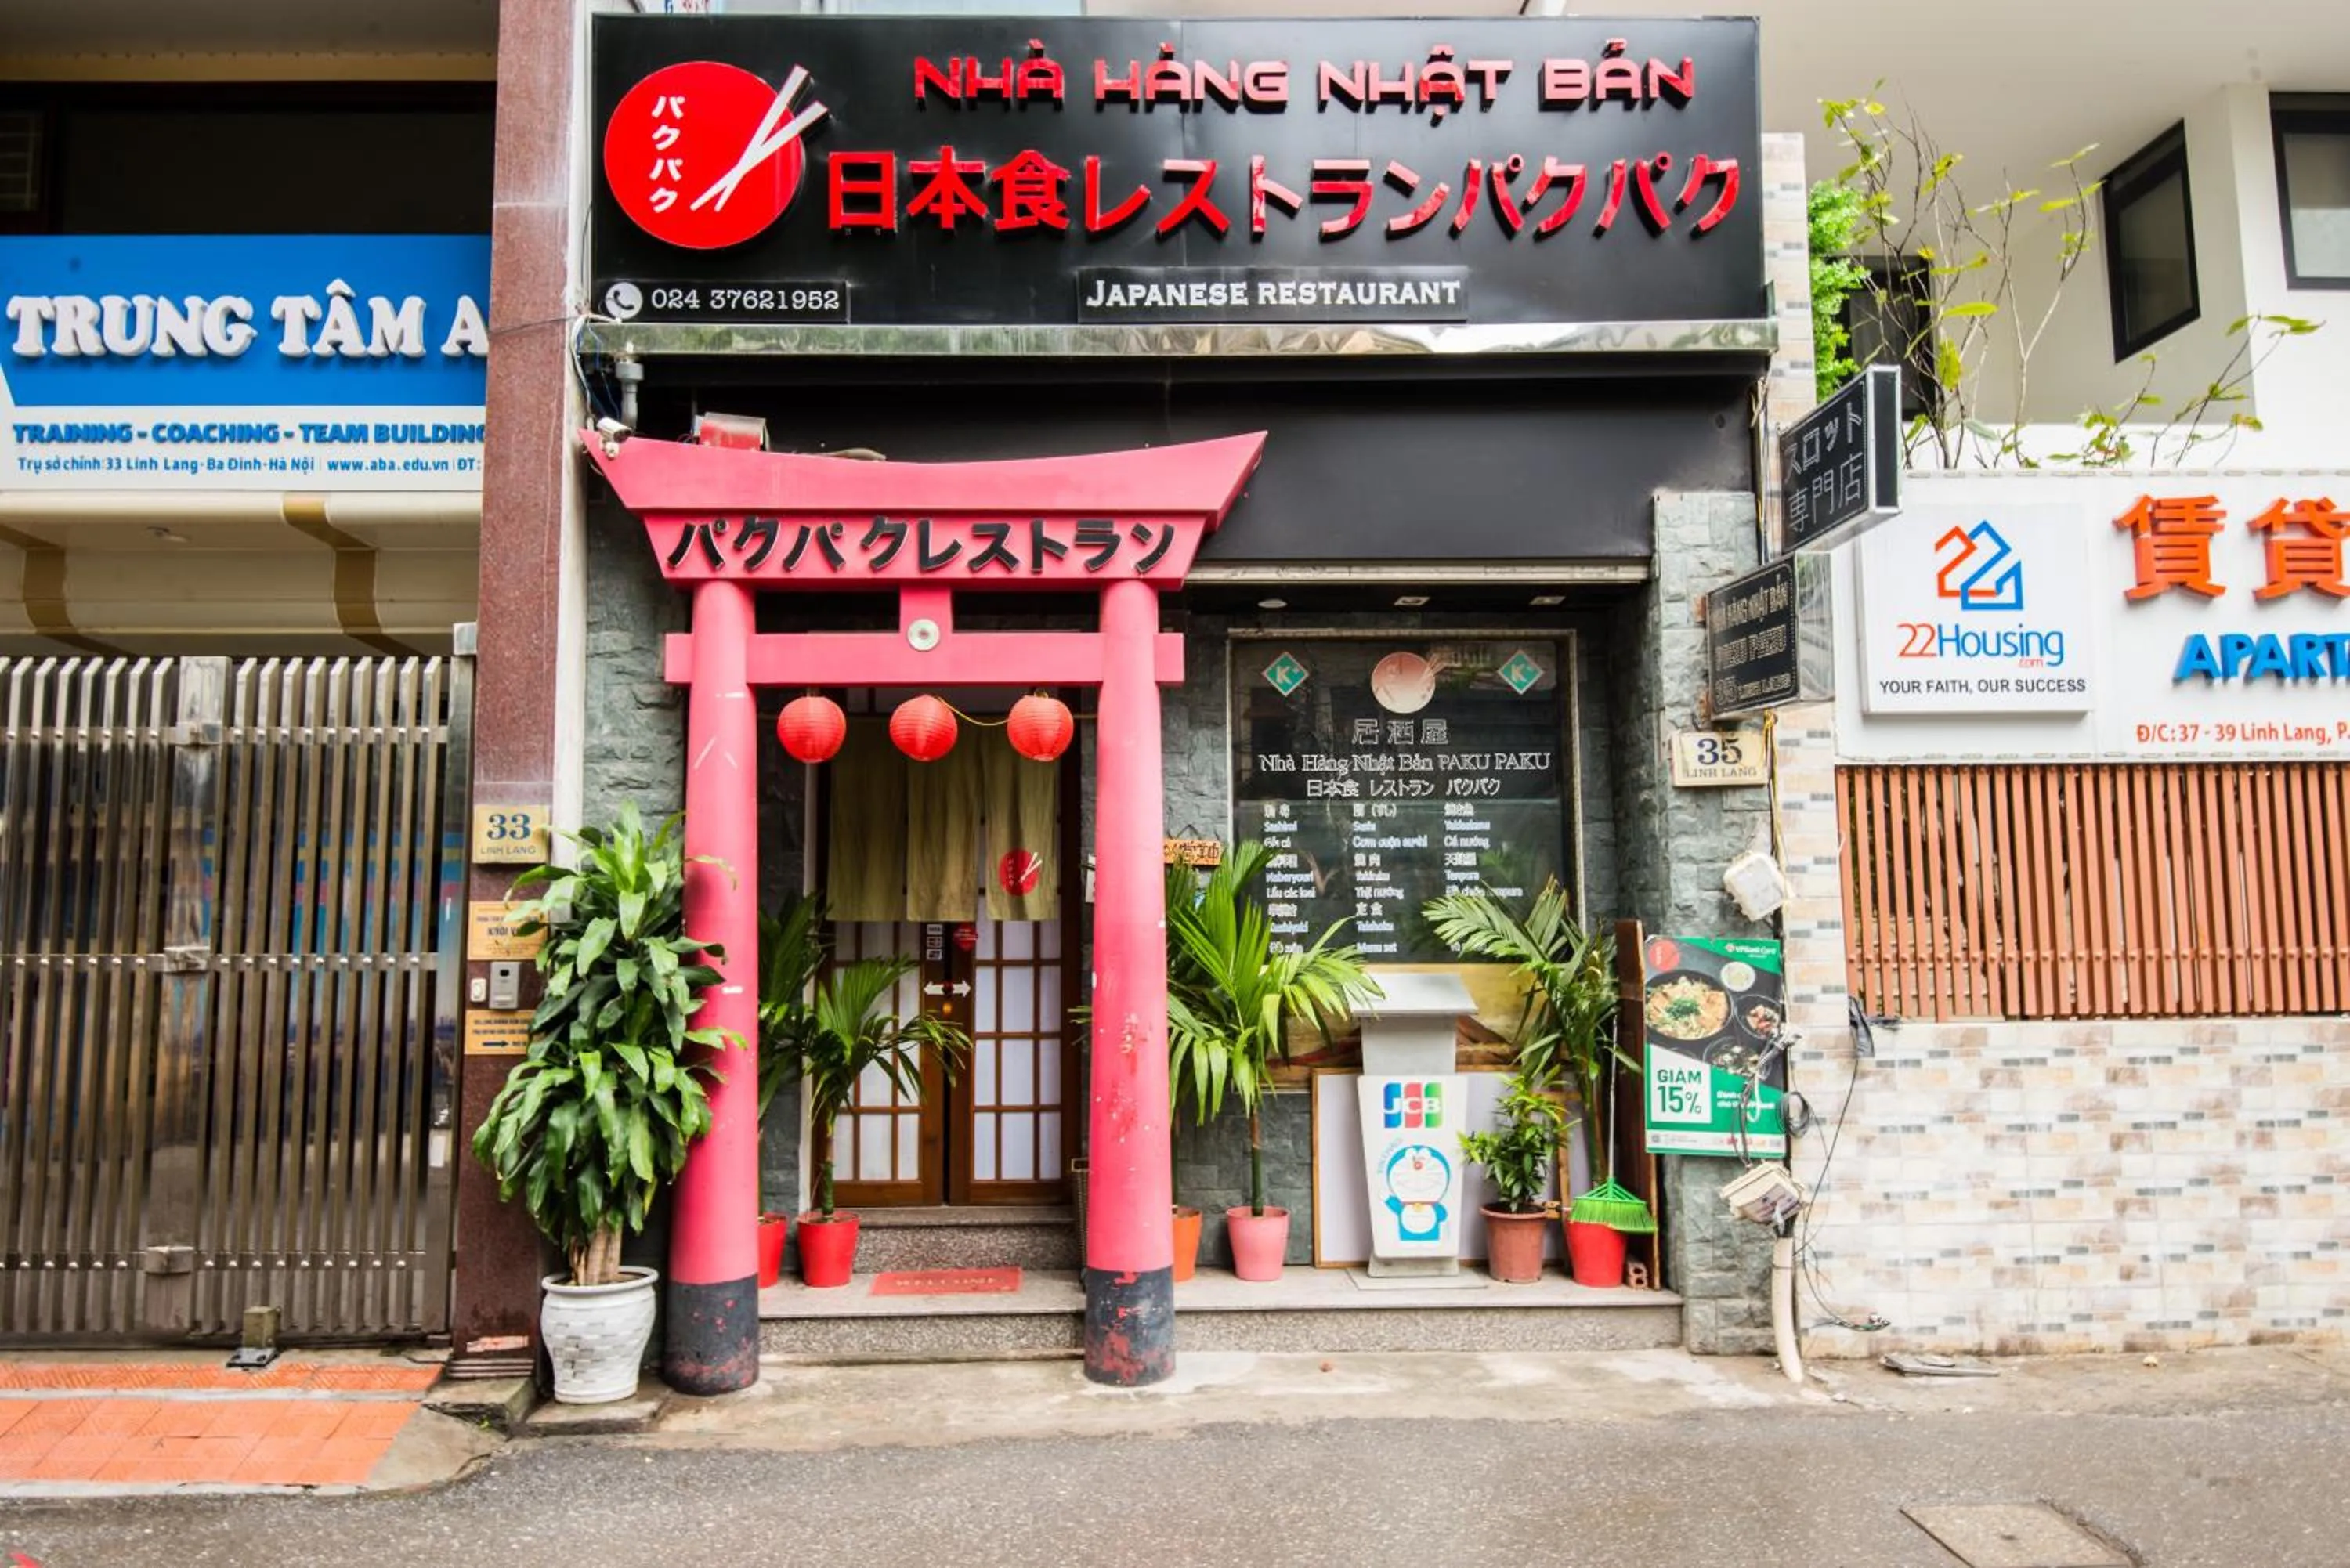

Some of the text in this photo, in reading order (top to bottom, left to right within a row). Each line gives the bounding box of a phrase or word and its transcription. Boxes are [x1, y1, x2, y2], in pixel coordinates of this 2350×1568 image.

[913, 38, 1695, 127] NHÀ HÀNG NHẬT BẢN
[649, 95, 686, 214] パクパク
[828, 145, 1741, 241] 日本食レストランパクパク
[651, 289, 841, 309] 024 37621952
[1086, 280, 1462, 308] JAPANESE RESTAURANT
[7, 295, 258, 359] TRUNG
[271, 278, 427, 359] TÂM
[13, 423, 133, 443] TRAINING
[151, 423, 280, 443] COACHING
[298, 423, 369, 443] TEAM
[1784, 401, 1863, 485] スロット
[18, 457, 42, 475] Trụ
[106, 457, 122, 470] 33
[126, 457, 157, 470] Linh
[291, 457, 314, 475] Nội
[327, 458, 449, 471] www.aba.edu.vn
[1788, 452, 1864, 533] 専門店
[667, 515, 1177, 573] パクパクレストラン
[2113, 494, 2350, 602] 賃貸
[1897, 623, 2064, 667] 22Housing
[1880, 679, 2086, 694] YOUR FAITH, OUR SUCCESS
[1352, 718, 1448, 745] 居酒屋
[2215, 724, 2236, 741] 39
[2241, 722, 2279, 741] Linh
[2283, 723, 2332, 745] Lang,
[1697, 739, 1742, 765] 35
[1258, 753, 1551, 779] Nhà Hàng Nhật Bản PAKU PAKU
[1687, 767, 1757, 778] LINH LANG
[1306, 779, 1501, 797] 日本食 レストラン パクパク
[486, 813, 531, 840] 33
[480, 846, 537, 855] LINH LANG
[1657, 1086, 1702, 1115] 15%
